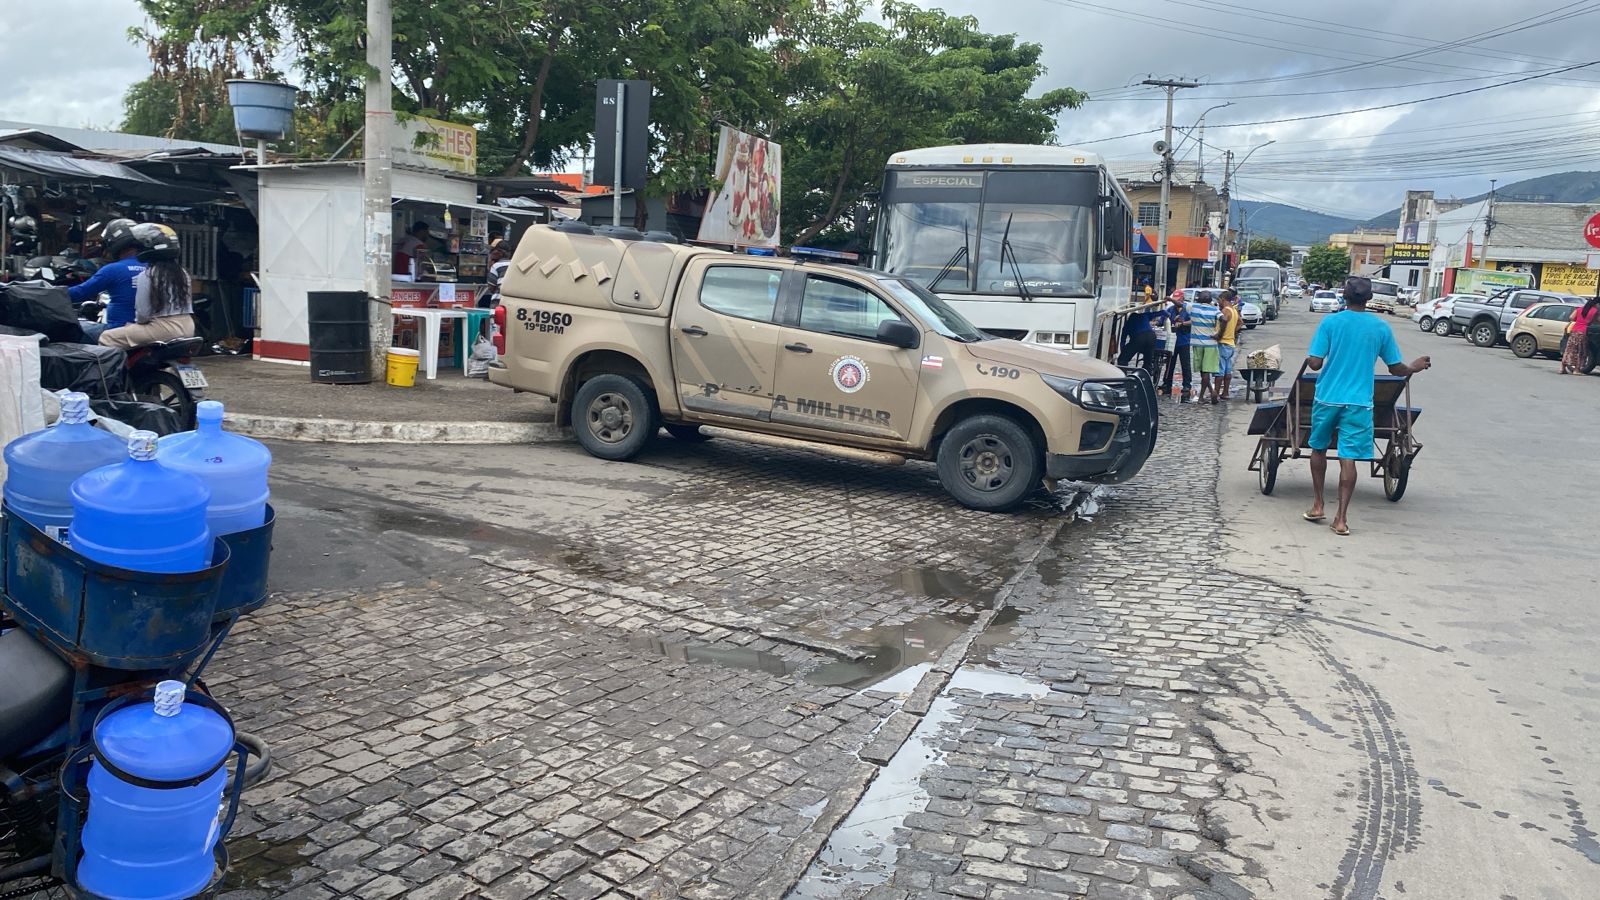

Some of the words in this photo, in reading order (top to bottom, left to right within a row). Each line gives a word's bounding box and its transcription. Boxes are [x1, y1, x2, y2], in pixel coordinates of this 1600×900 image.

[912, 176, 977, 187] ESPECIAL
[1393, 250, 1411, 258] R$20
[1545, 266, 1566, 274] TEMOS
[1569, 266, 1588, 275] TODOS
[1572, 273, 1593, 281] RAÇÃO
[516, 307, 573, 327] 8.1960
[990, 366, 1020, 380] 190
[796, 398, 891, 427] MILITAR
